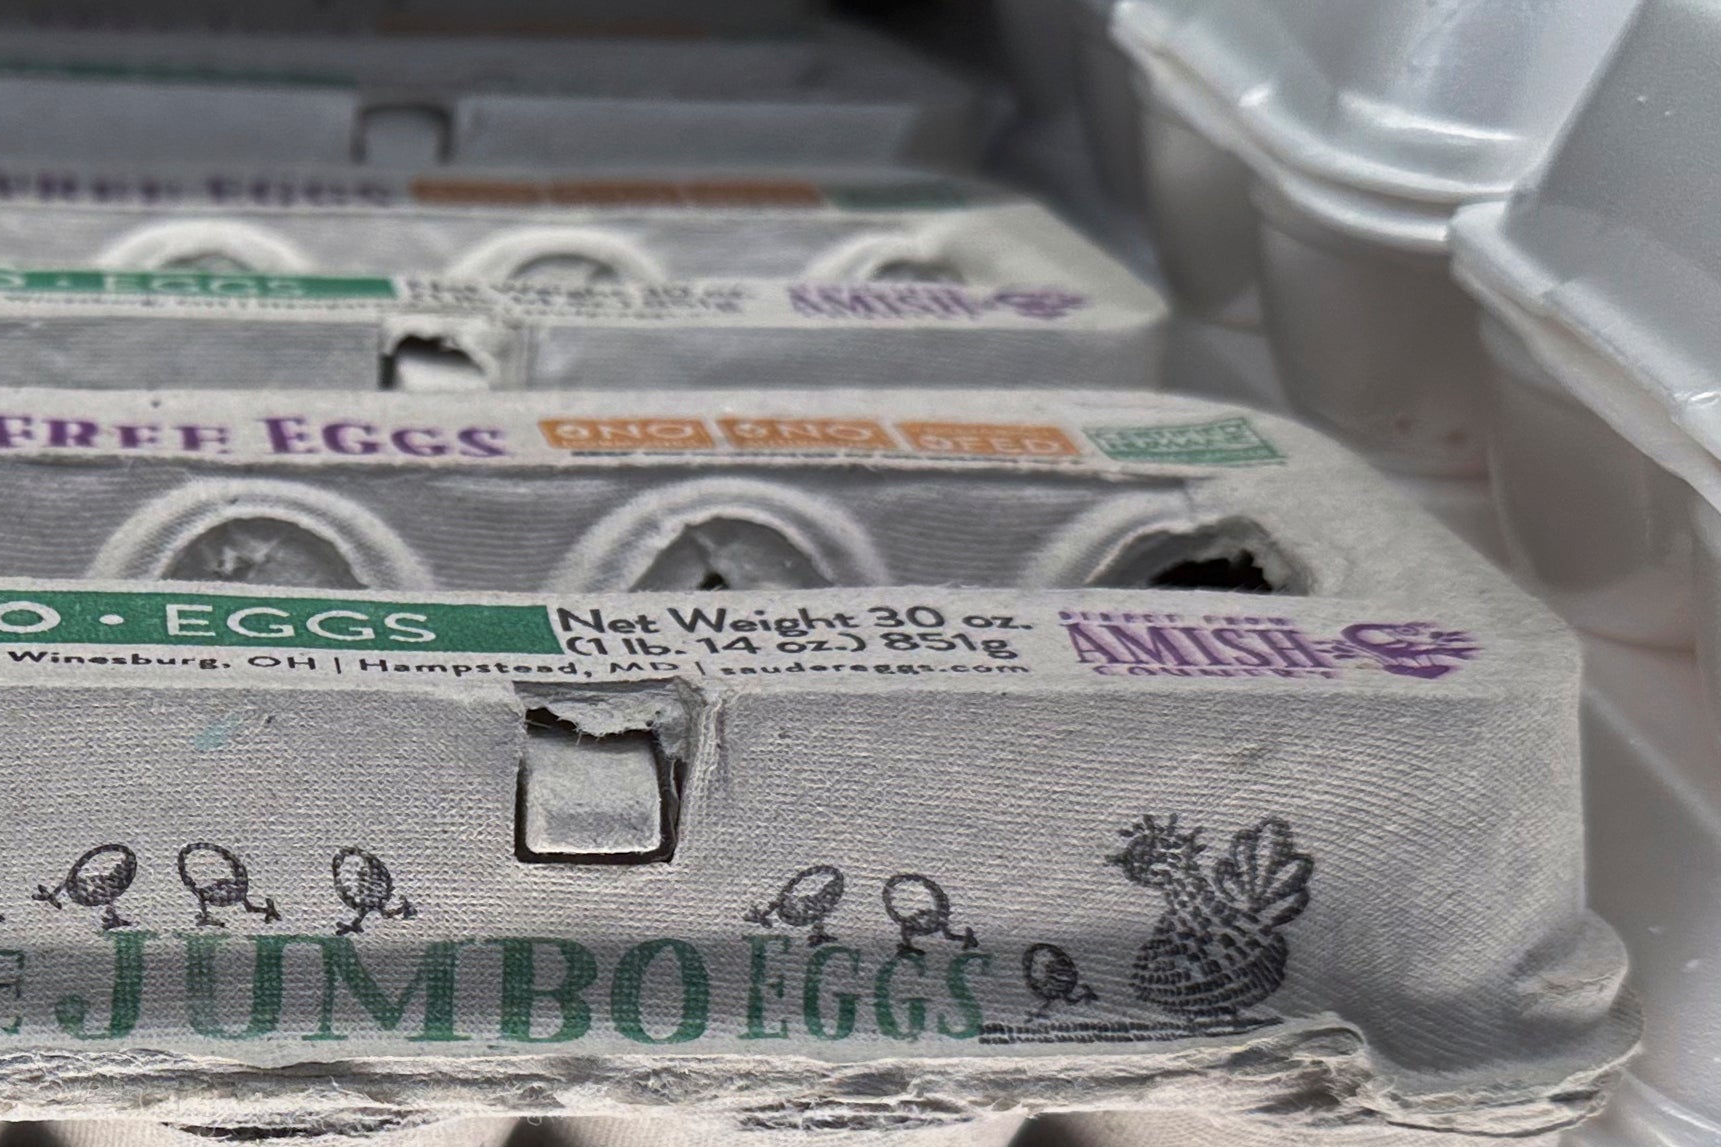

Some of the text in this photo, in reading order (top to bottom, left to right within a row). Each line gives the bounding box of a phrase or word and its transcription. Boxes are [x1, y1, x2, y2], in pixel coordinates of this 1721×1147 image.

[102, 276, 305, 297] EGGS
[258, 416, 508, 460] EGGS
[165, 603, 437, 644] EGGS
[556, 605, 1033, 639] Net Weight 30 oz.
[8, 650, 231, 670] Winesburg,
[246, 655, 316, 671] OH
[360, 657, 594, 679] Hampstead,
[608, 660, 679, 674] MD
[720, 662, 1031, 678] saudereggs.com
[565, 631, 1020, 661] (1 lb. 14 oz.) 851g
[1063, 622, 1338, 670] AMISH
[54, 928, 711, 1047] JUMBO
[745, 932, 996, 1043] EGGS
